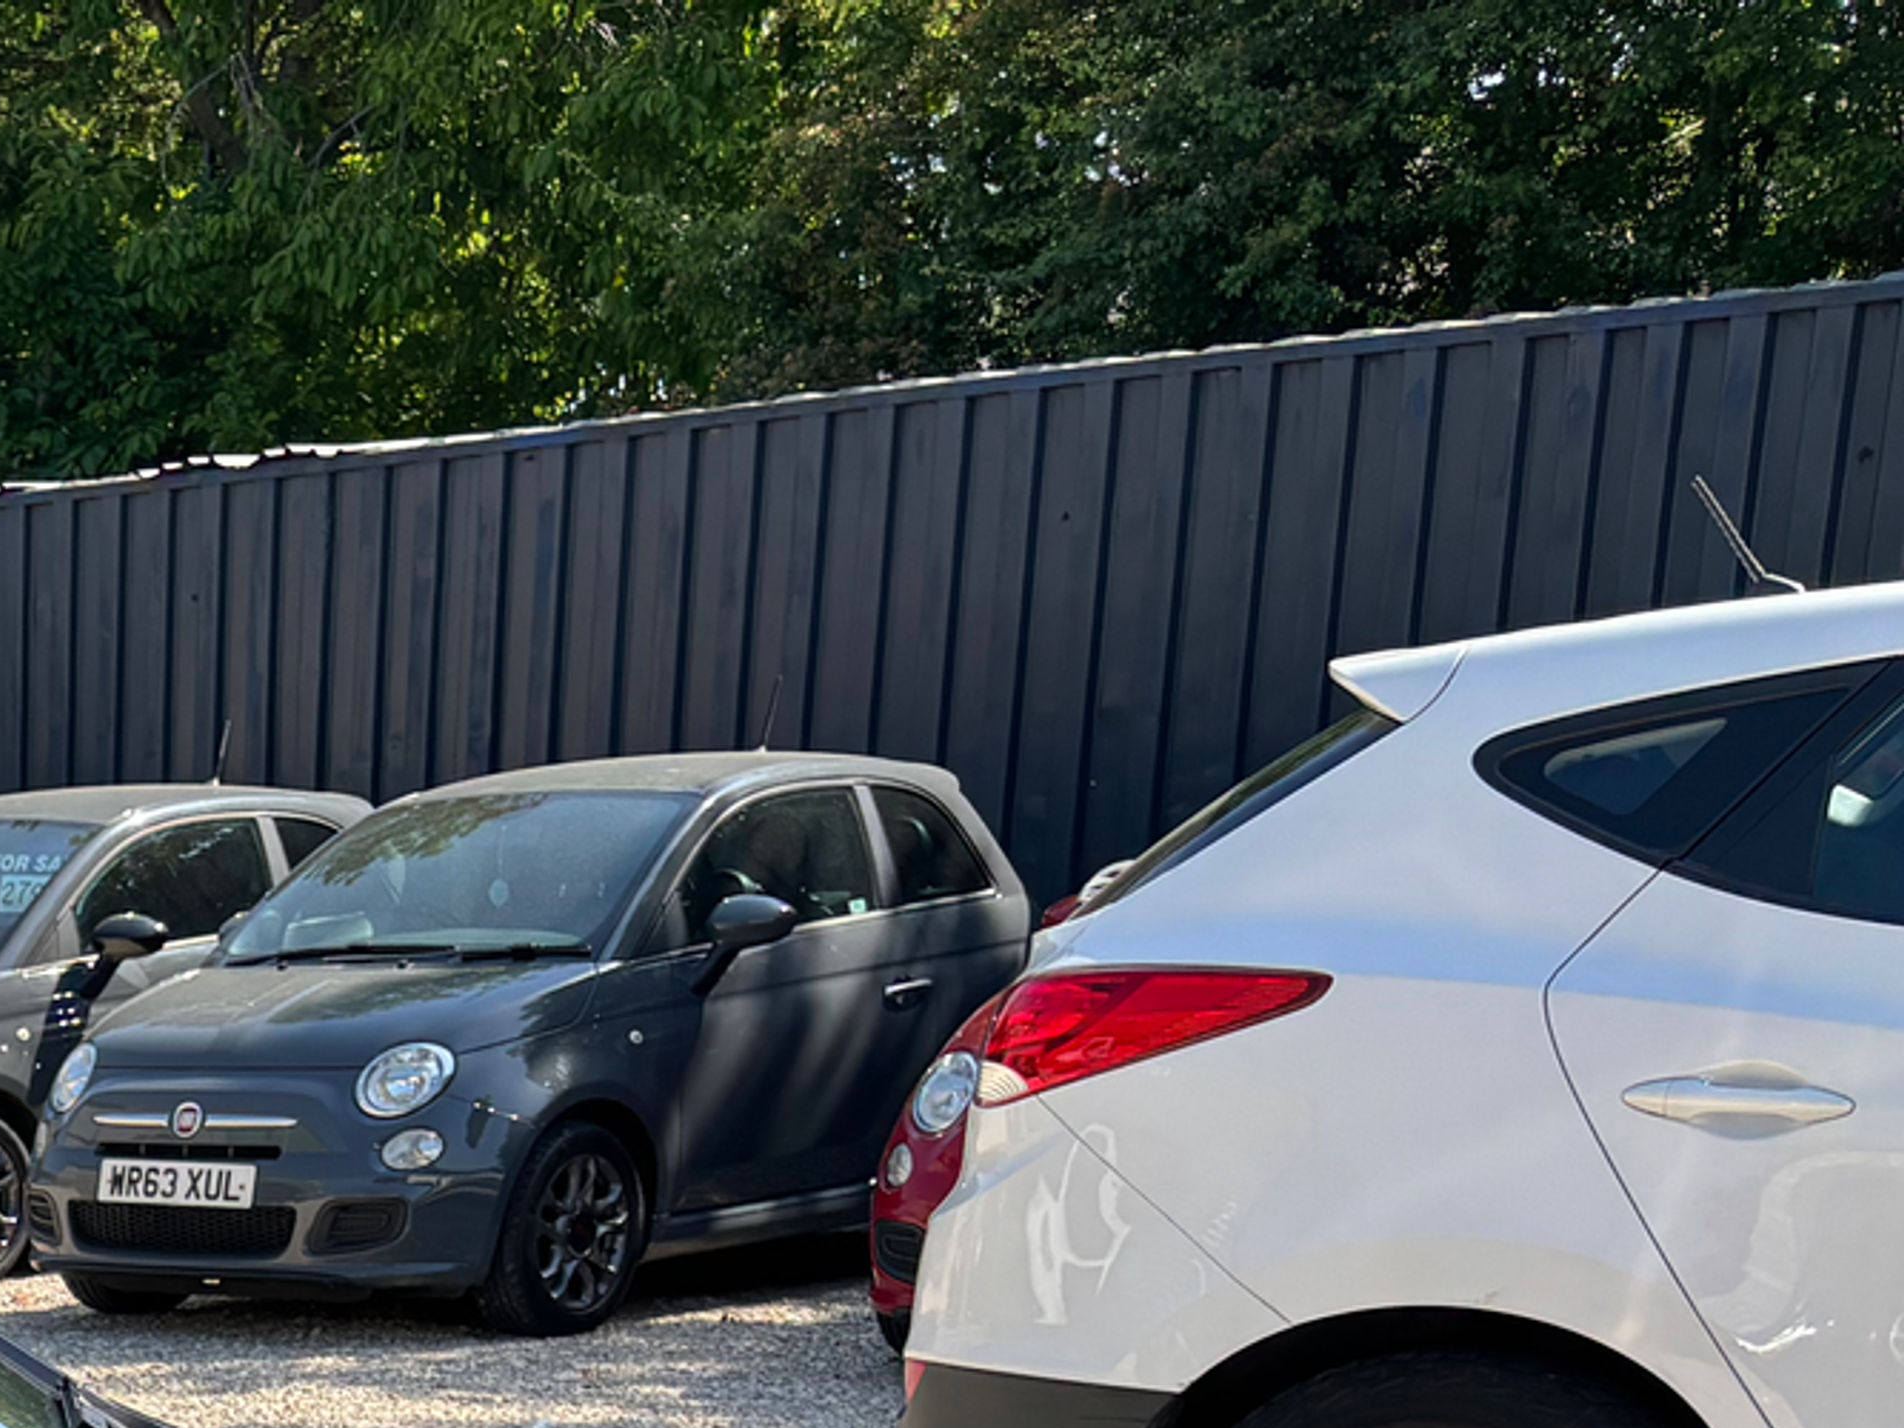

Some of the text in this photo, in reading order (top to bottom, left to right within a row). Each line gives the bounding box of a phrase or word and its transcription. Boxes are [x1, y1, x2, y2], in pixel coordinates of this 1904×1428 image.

[34, 853, 64, 872] SA
[110, 1165, 240, 1201] WR63 XUL
